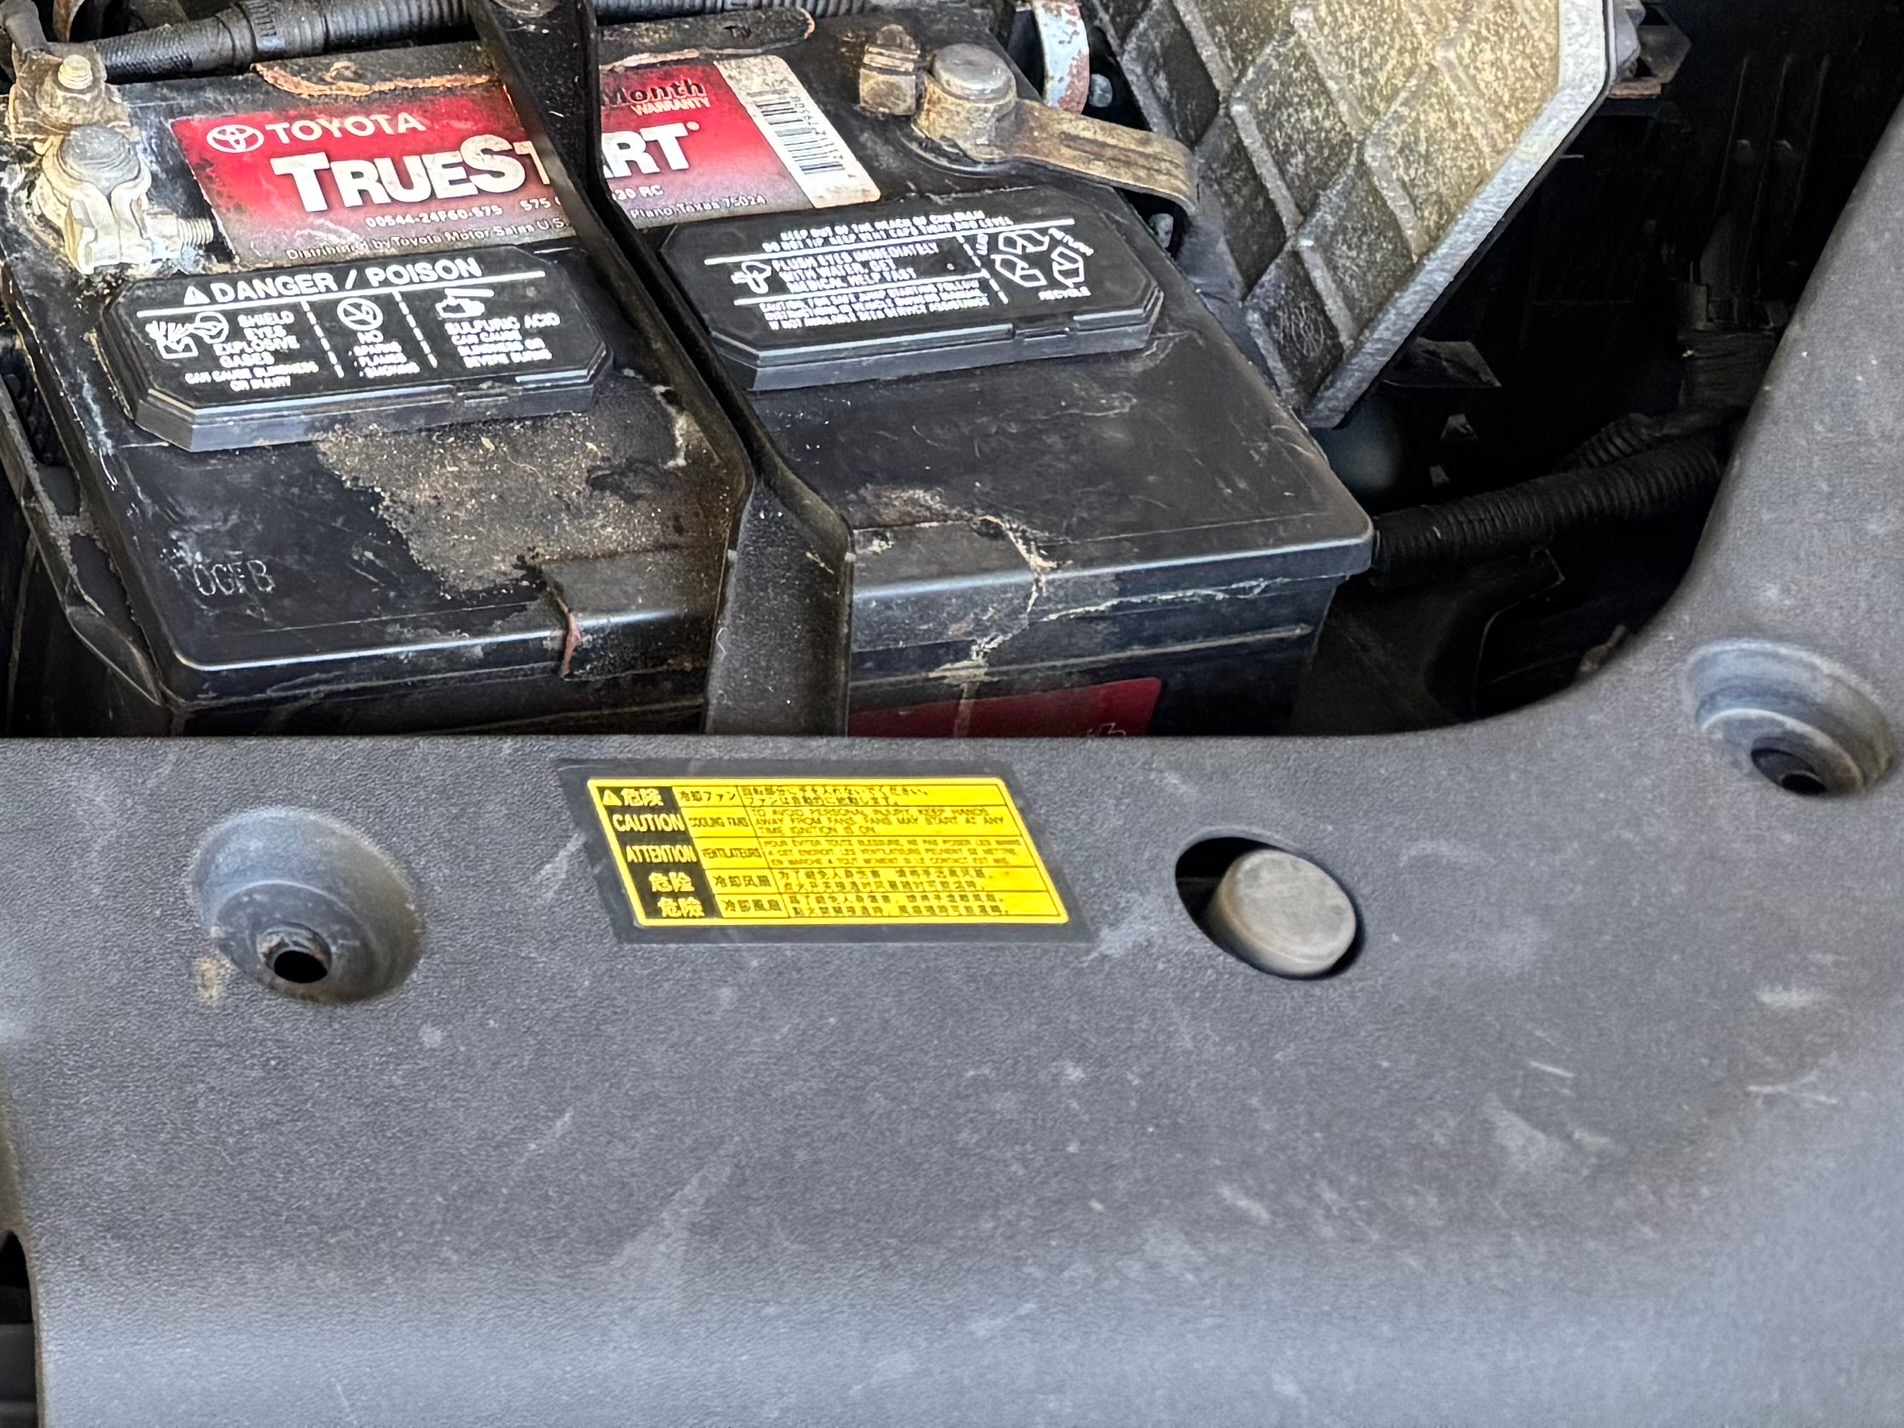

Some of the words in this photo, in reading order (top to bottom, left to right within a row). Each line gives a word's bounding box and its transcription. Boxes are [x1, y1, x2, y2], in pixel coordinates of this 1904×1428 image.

[631, 96, 712, 116] WARRANTY
[265, 111, 426, 145] TOYOTA
[286, 240, 367, 261] Distributed
[392, 233, 442, 251] Toyota
[445, 227, 490, 244] Motor
[494, 223, 535, 239] Sales
[677, 199, 721, 215] Texas
[723, 194, 767, 210] 75024
[772, 255, 817, 273] FLUSH
[820, 250, 852, 268] EYES
[852, 242, 940, 263] IMMEDIATELY
[209, 272, 338, 303] DANGER
[365, 257, 483, 287] POISON
[778, 268, 817, 284] WITH
[871, 258, 897, 273] GET
[848, 272, 881, 288] HELP
[881, 267, 917, 282] FAST
[238, 310, 295, 328] SHIELD
[444, 316, 521, 336] SULFURIC
[524, 312, 561, 330] ACID
[243, 325, 288, 342] EYES
[356, 330, 384, 344] NO
[213, 335, 301, 356] EXPLOSIVE
[219, 351, 275, 368] GASES
[689, 816, 725, 828] COOLING
[727, 816, 749, 828] FANS
[753, 808, 765, 817] TO
[756, 817, 783, 826] AWAY
[791, 817, 821, 826] FROM
[897, 817, 918, 825] MAY
[925, 817, 958, 826] START
[983, 816, 1004, 825] ANY
[612, 813, 686, 832] CAUTION
[759, 826, 782, 835] TIME
[626, 845, 697, 863] ATTENTION
